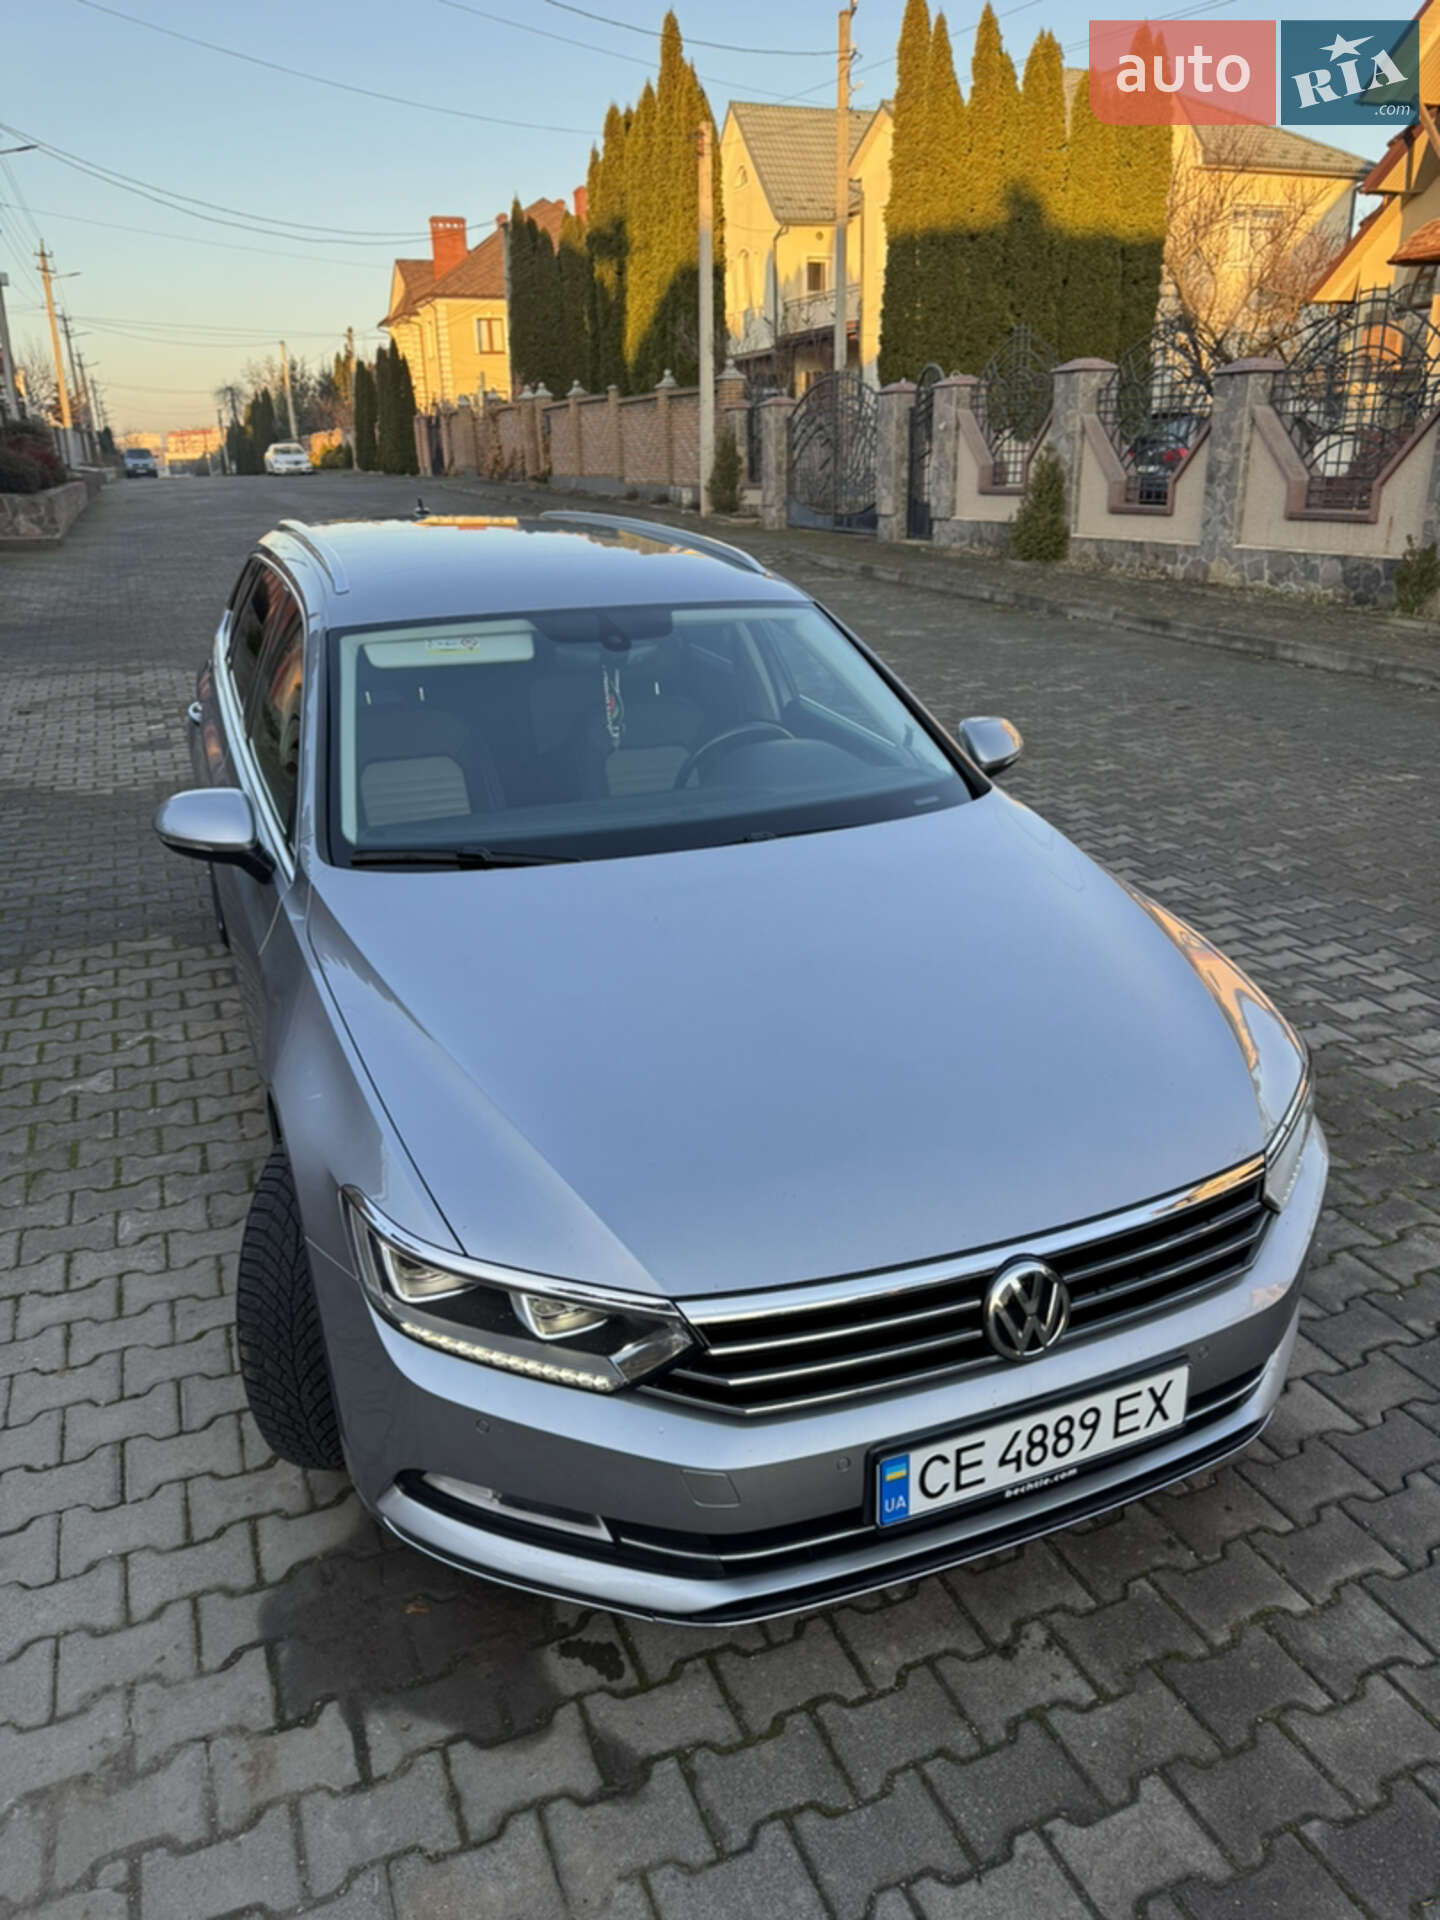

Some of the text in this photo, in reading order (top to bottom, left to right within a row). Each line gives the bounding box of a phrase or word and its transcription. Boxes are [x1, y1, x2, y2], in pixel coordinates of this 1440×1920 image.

[919, 1380, 1173, 1500] CE 4889 EX
[885, 1494, 906, 1513] UA
